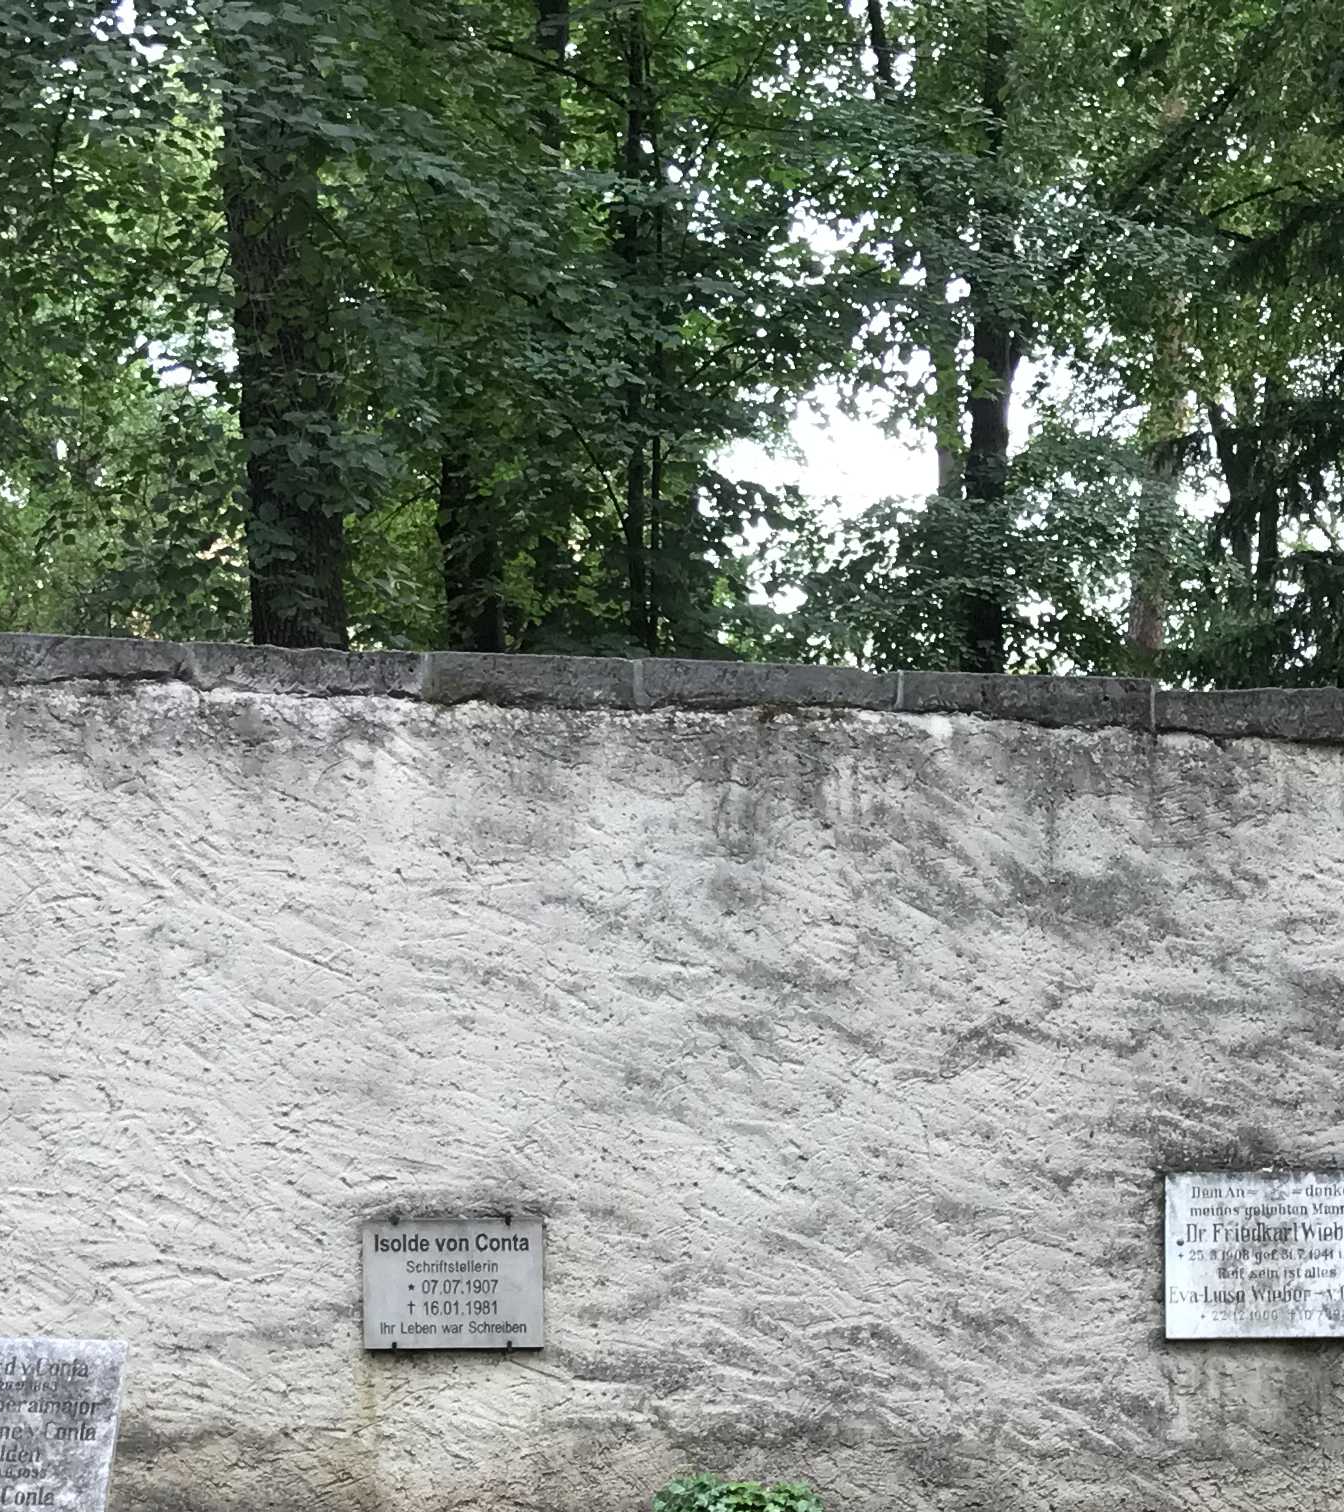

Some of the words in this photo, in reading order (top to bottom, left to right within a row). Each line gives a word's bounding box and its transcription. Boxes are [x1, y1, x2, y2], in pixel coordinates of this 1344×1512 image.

[1191, 1186, 1222, 1199] Dem
[1190, 1205, 1240, 1217] meines
[1244, 1203, 1308, 1220] geliebten
[1212, 1222, 1298, 1243] Friedkarl
[373, 1233, 430, 1252] Isolde
[435, 1237, 470, 1252] von
[474, 1232, 530, 1252] Conta
[406, 1260, 499, 1274] Schriftstellerin
[1283, 1267, 1301, 1279] ist
[1304, 1266, 1337, 1279] alles
[421, 1279, 499, 1295] 07.07.1907
[423, 1300, 498, 1316] 16.01.1981
[379, 1321, 396, 1335] Ihr
[400, 1321, 437, 1335] Leben
[441, 1323, 464, 1334] war
[468, 1320, 527, 1334] Schreiben
